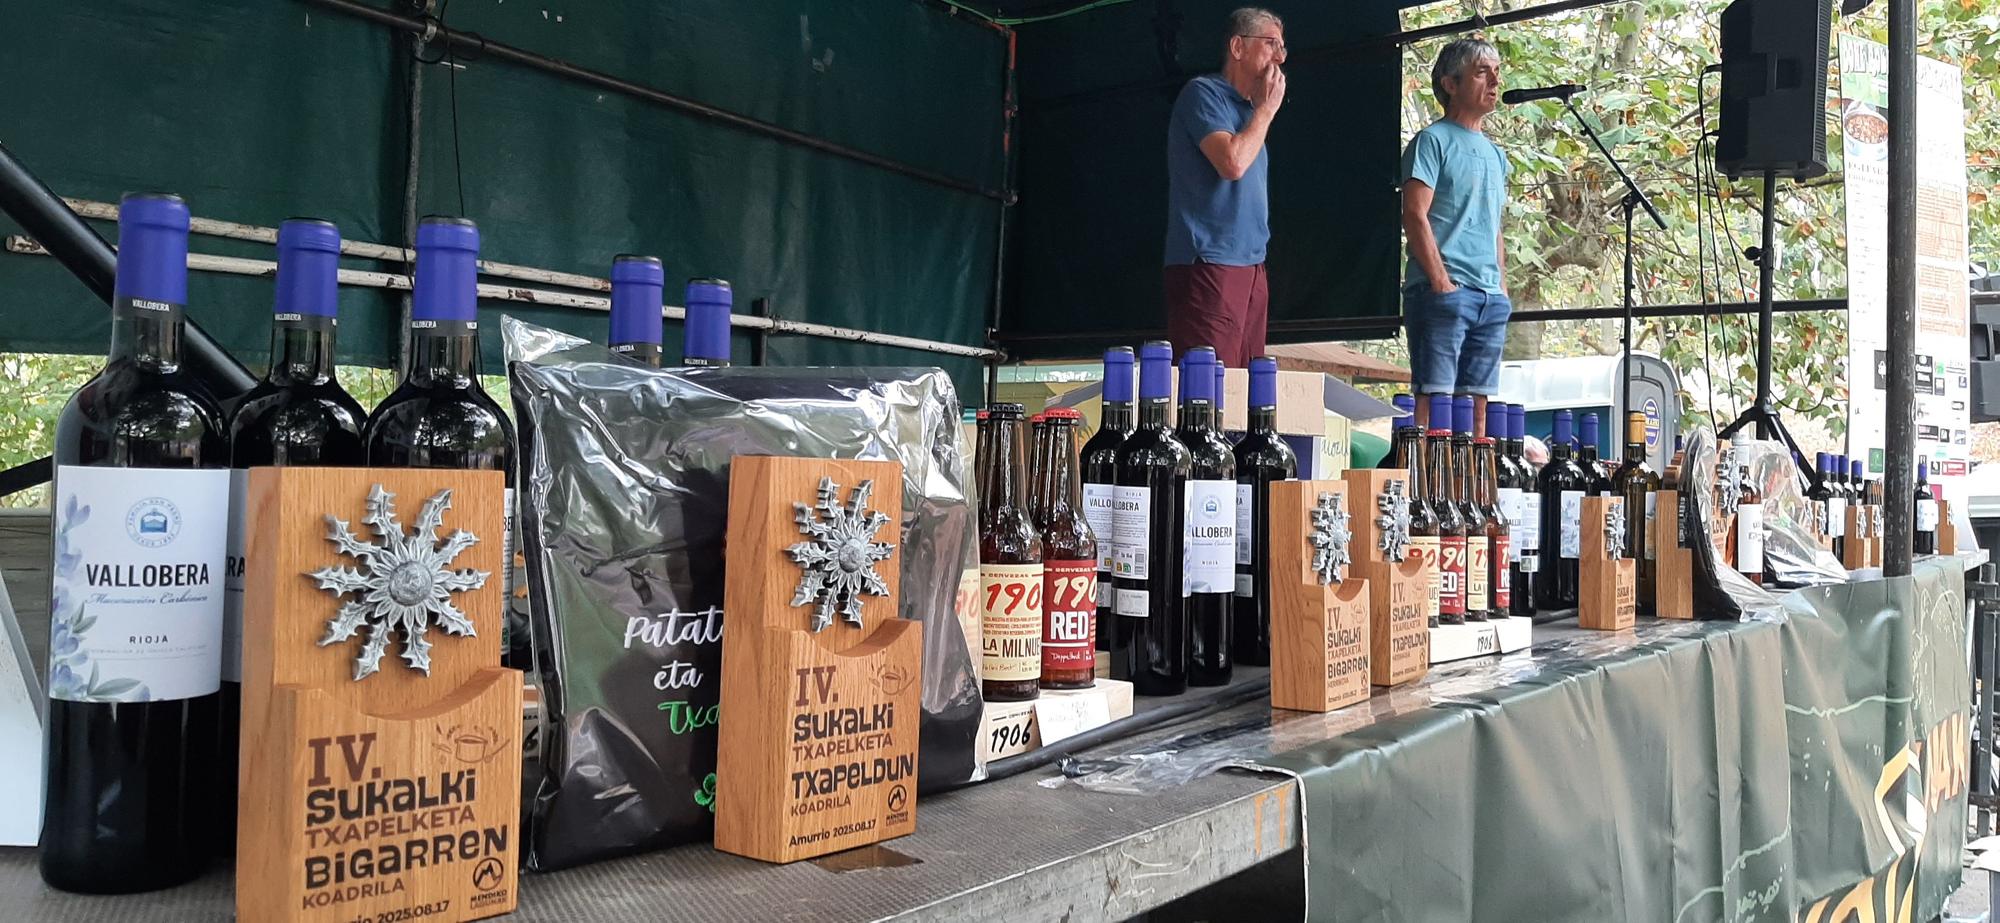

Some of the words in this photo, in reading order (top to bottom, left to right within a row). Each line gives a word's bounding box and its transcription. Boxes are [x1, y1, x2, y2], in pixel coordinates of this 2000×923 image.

[132, 298, 170, 312] VALLOBERA
[86, 563, 210, 588] VALLOBERA
[1050, 610, 1089, 640] RED
[1327, 606, 1342, 631] IV.
[129, 635, 169, 645] RIOJA
[982, 637, 998, 651] LA
[653, 659, 704, 690] eta
[795, 665, 838, 707] IV.
[792, 733, 893, 762] TXAPELKETA
[991, 718, 1033, 753] 1906
[307, 731, 382, 788] IV.
[790, 795, 851, 817] KOADRILA
[305, 805, 476, 850] TXAPELKETA
[789, 828, 831, 848] Amurrio
[302, 878, 406, 911] KOADRILA
